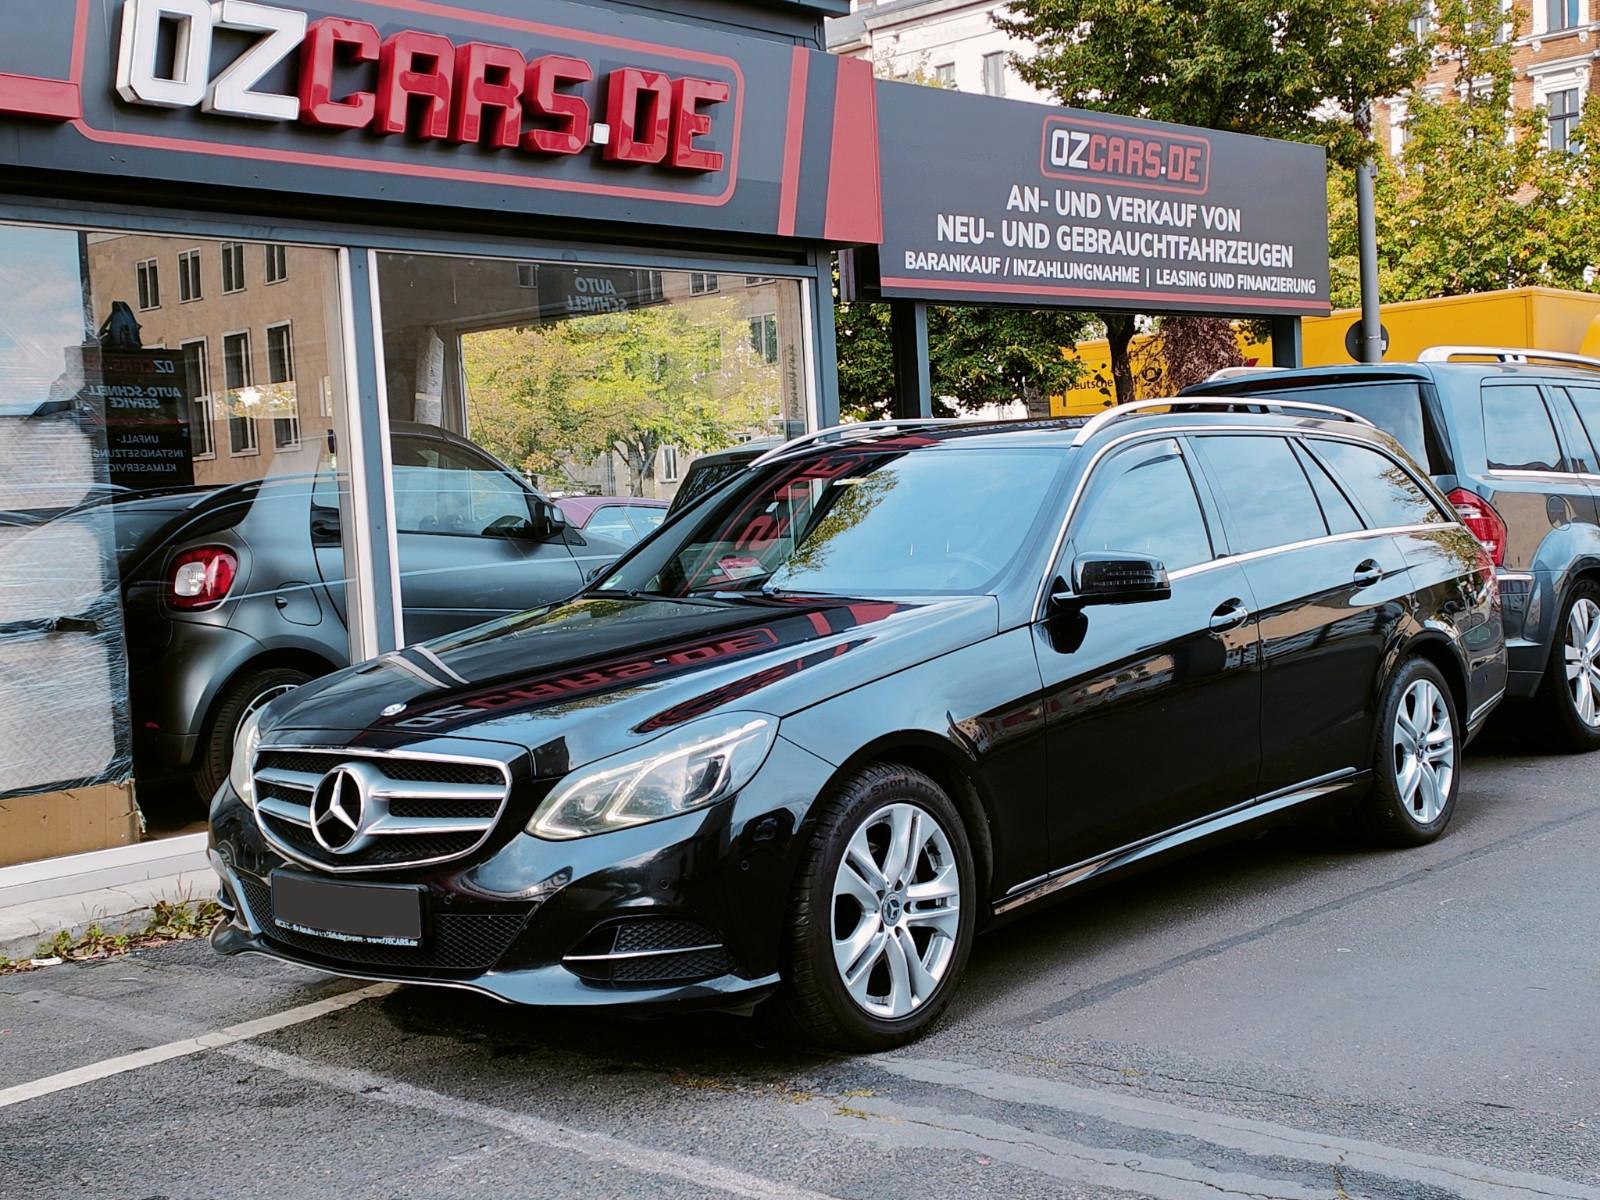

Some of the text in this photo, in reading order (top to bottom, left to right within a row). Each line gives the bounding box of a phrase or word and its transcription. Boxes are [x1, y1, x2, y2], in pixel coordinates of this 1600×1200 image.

[116, 0, 731, 172] OZCARS.DE
[1050, 129, 1202, 184] OZCARS.DE
[1006, 184, 1240, 232] AN- UND VERKAUF VON
[937, 214, 1293, 268] NEU- UND GEBRAUCHTFAHRZEUGEN
[905, 251, 1000, 275] BARANKAUF
[1013, 258, 1140, 284] INZAHLUNGNAHME
[1156, 268, 1207, 288] LEASING
[1209, 272, 1235, 290] UND
[1237, 274, 1317, 295] FINANZIERUNG
